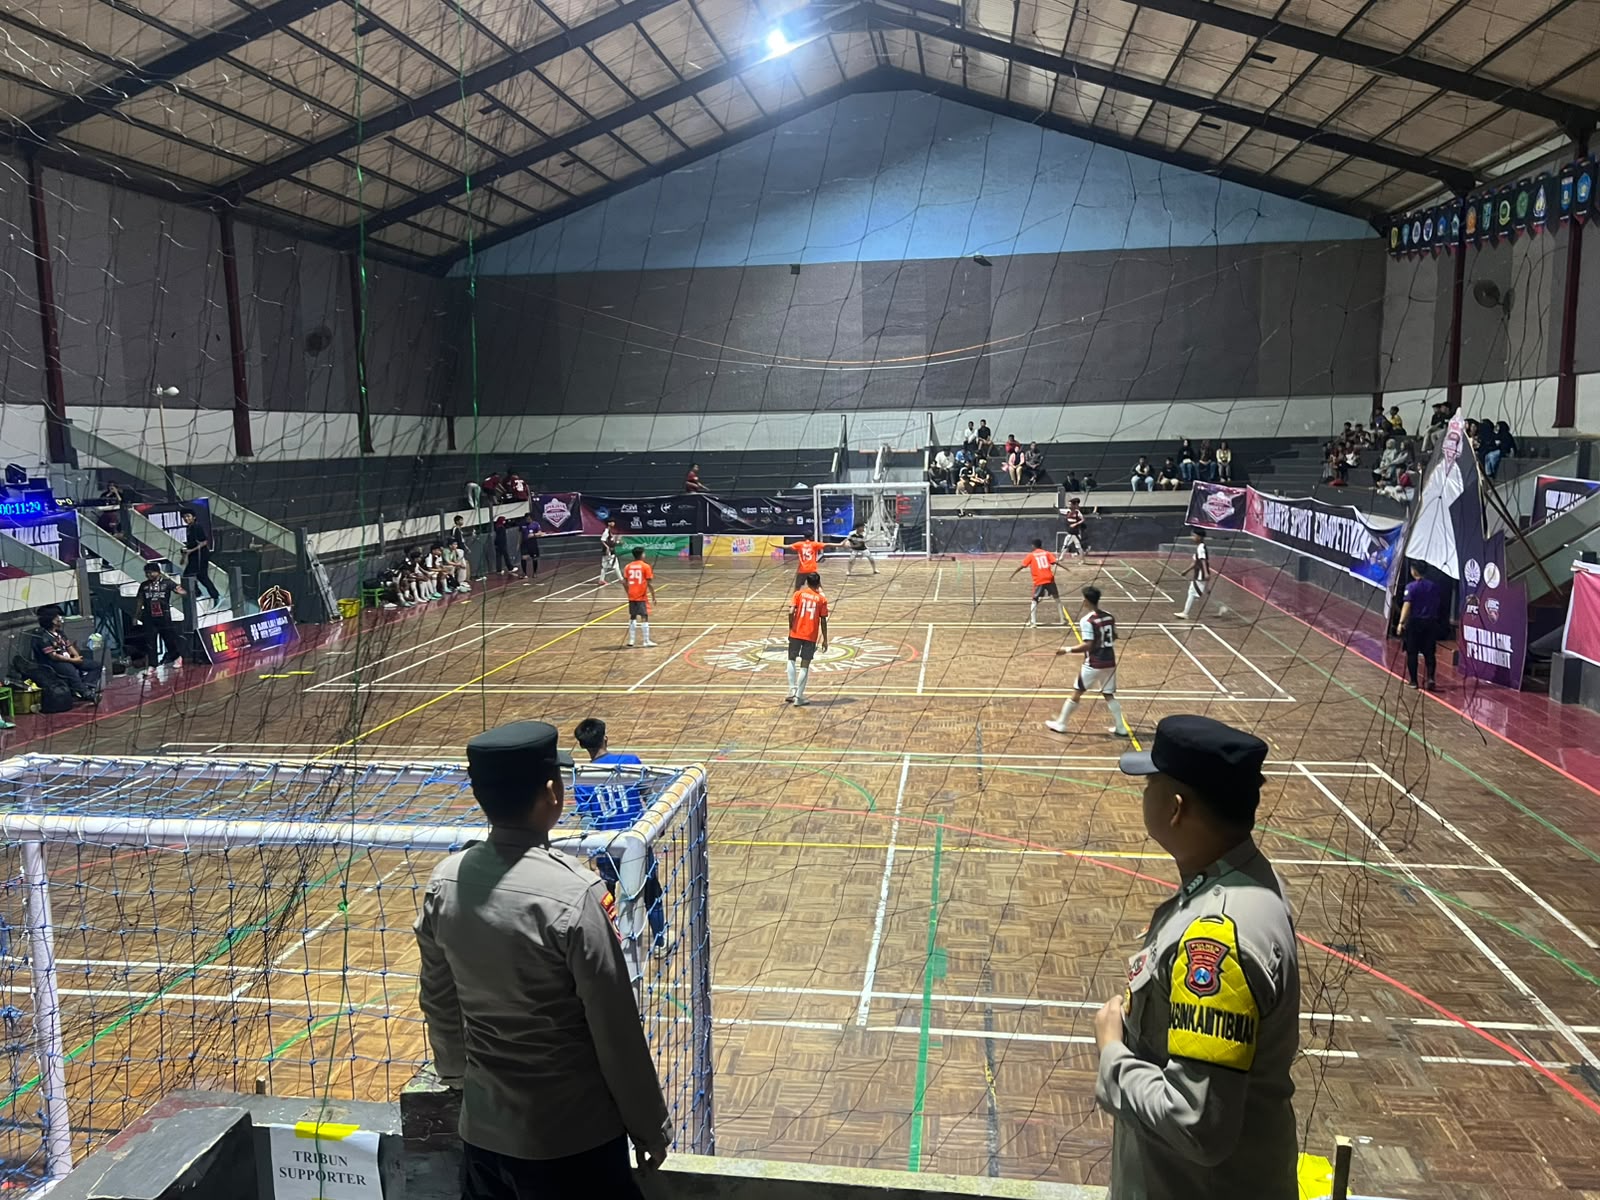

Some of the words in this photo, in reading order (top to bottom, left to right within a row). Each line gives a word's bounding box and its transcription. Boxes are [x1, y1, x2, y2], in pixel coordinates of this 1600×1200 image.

[800, 598, 816, 620] 14
[1099, 624, 1113, 648] 13
[293, 1150, 348, 1167] TRIBUN
[279, 1166, 367, 1186] SUPPORTER
